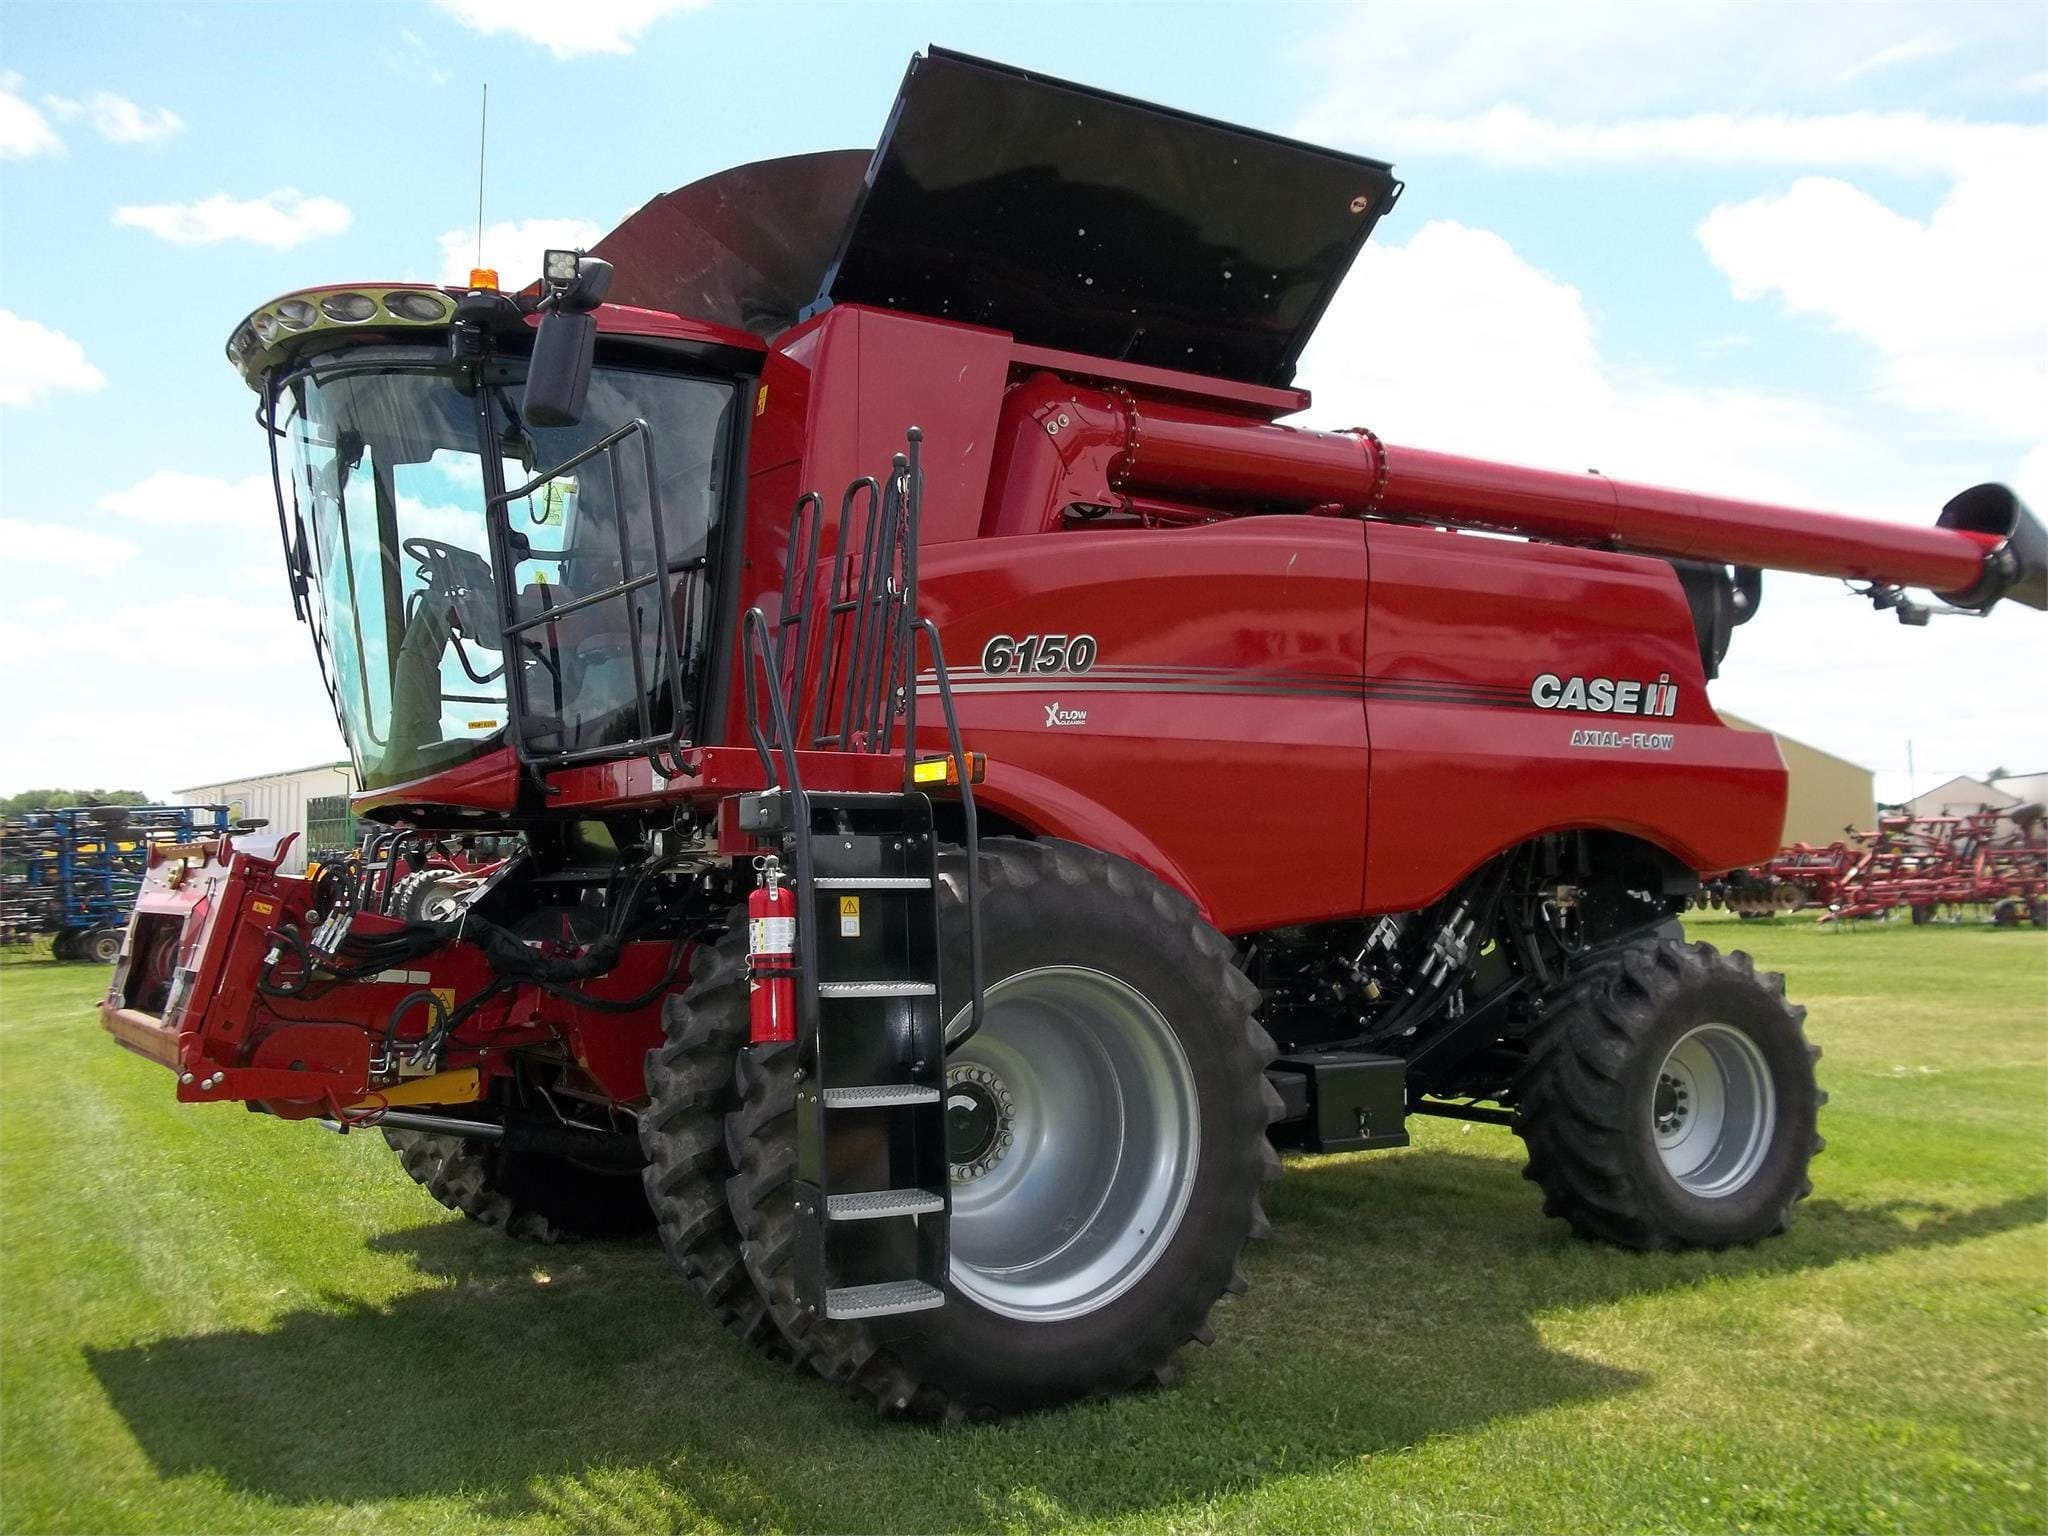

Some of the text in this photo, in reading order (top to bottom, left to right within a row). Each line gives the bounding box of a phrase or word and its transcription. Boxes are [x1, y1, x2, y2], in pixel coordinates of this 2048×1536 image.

[983, 635, 1097, 675] 6150
[1531, 673, 1641, 714] CASE
[1571, 730, 1673, 749] AXIAL-FLOW
